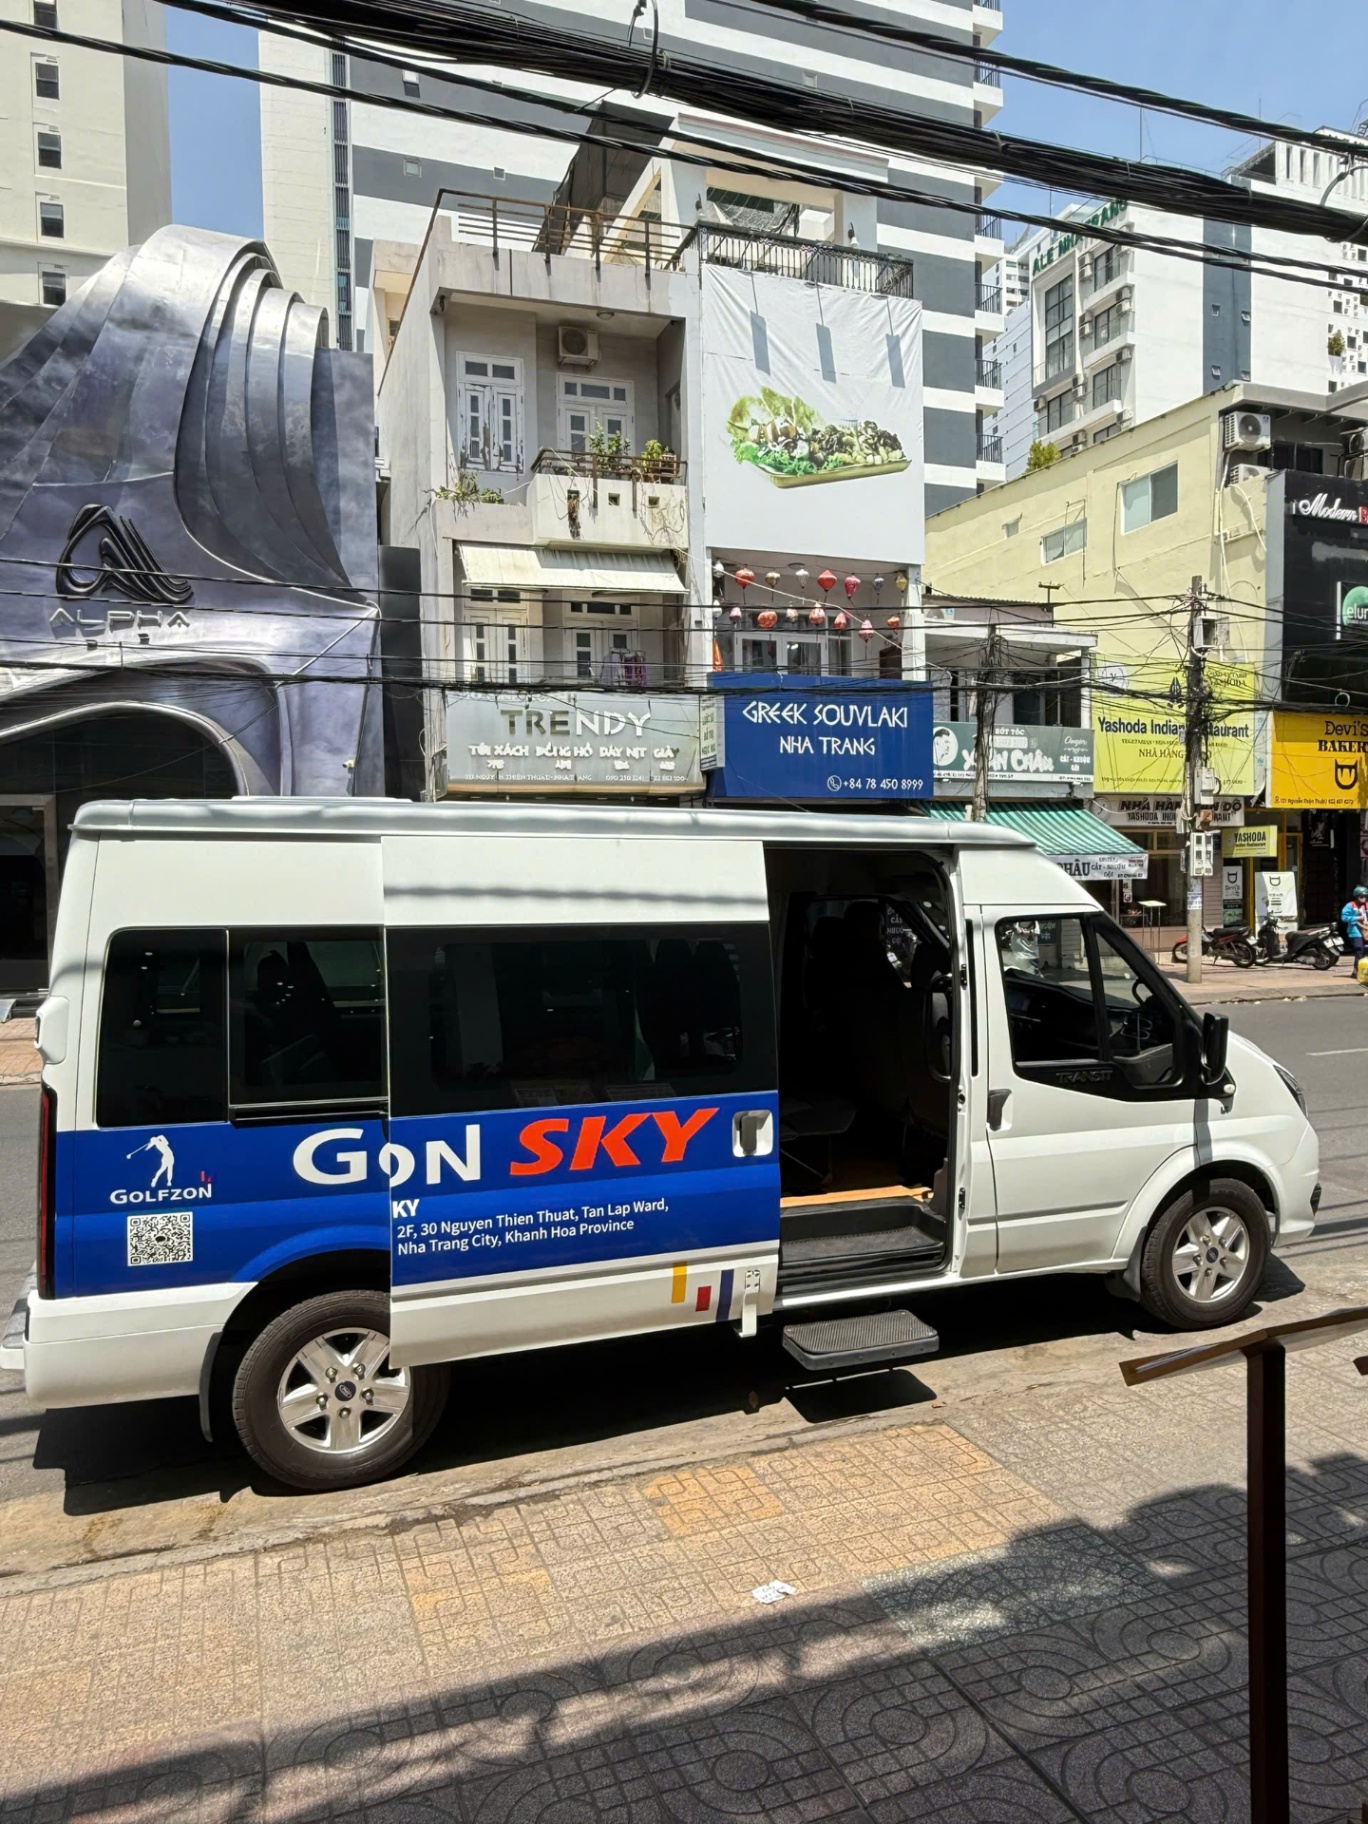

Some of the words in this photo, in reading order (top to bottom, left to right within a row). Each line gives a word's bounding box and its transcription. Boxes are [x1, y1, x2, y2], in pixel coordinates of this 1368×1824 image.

[1033, 246, 1054, 276] ALE
[48, 607, 191, 629] ALPHA
[500, 709, 651, 736] TRENDY
[742, 700, 808, 725] GREEK
[813, 703, 908, 728] SOUVLAKI
[1098, 716, 1147, 734] Yashoda
[1324, 720, 1368, 737] Devi's
[779, 735, 814, 755] NHA
[819, 736, 875, 756] TRANG
[568, 773, 592, 781] TANG
[843, 778, 862, 790] +84
[865, 778, 877, 789] 78
[880, 778, 898, 790] 450
[901, 779, 924, 791] 8999
[1155, 797, 1181, 812] HÀ
[1127, 812, 1158, 821] YASHODA
[1234, 831, 1266, 842] YASHODA
[1056, 858, 1091, 877] HÂU
[509, 1107, 720, 1176] SKY
[109, 1182, 212, 1204] GOLFZON
[397, 1224, 418, 1239] 2F,
[420, 1222, 438, 1236] 30
[441, 1218, 493, 1236] Nguyen
[496, 1213, 534, 1228] Thien
[537, 1208, 579, 1224] Thuat,
[582, 1205, 604, 1219] Tan
[608, 1203, 631, 1218] Lap
[633, 1197, 669, 1213] Ward,
[398, 1241, 426, 1256] Nha
[429, 1238, 469, 1252] Trang
[472, 1233, 502, 1249] City,
[505, 1227, 548, 1244] Khanh
[551, 1225, 576, 1239] Hoa
[580, 1219, 635, 1236] Province
